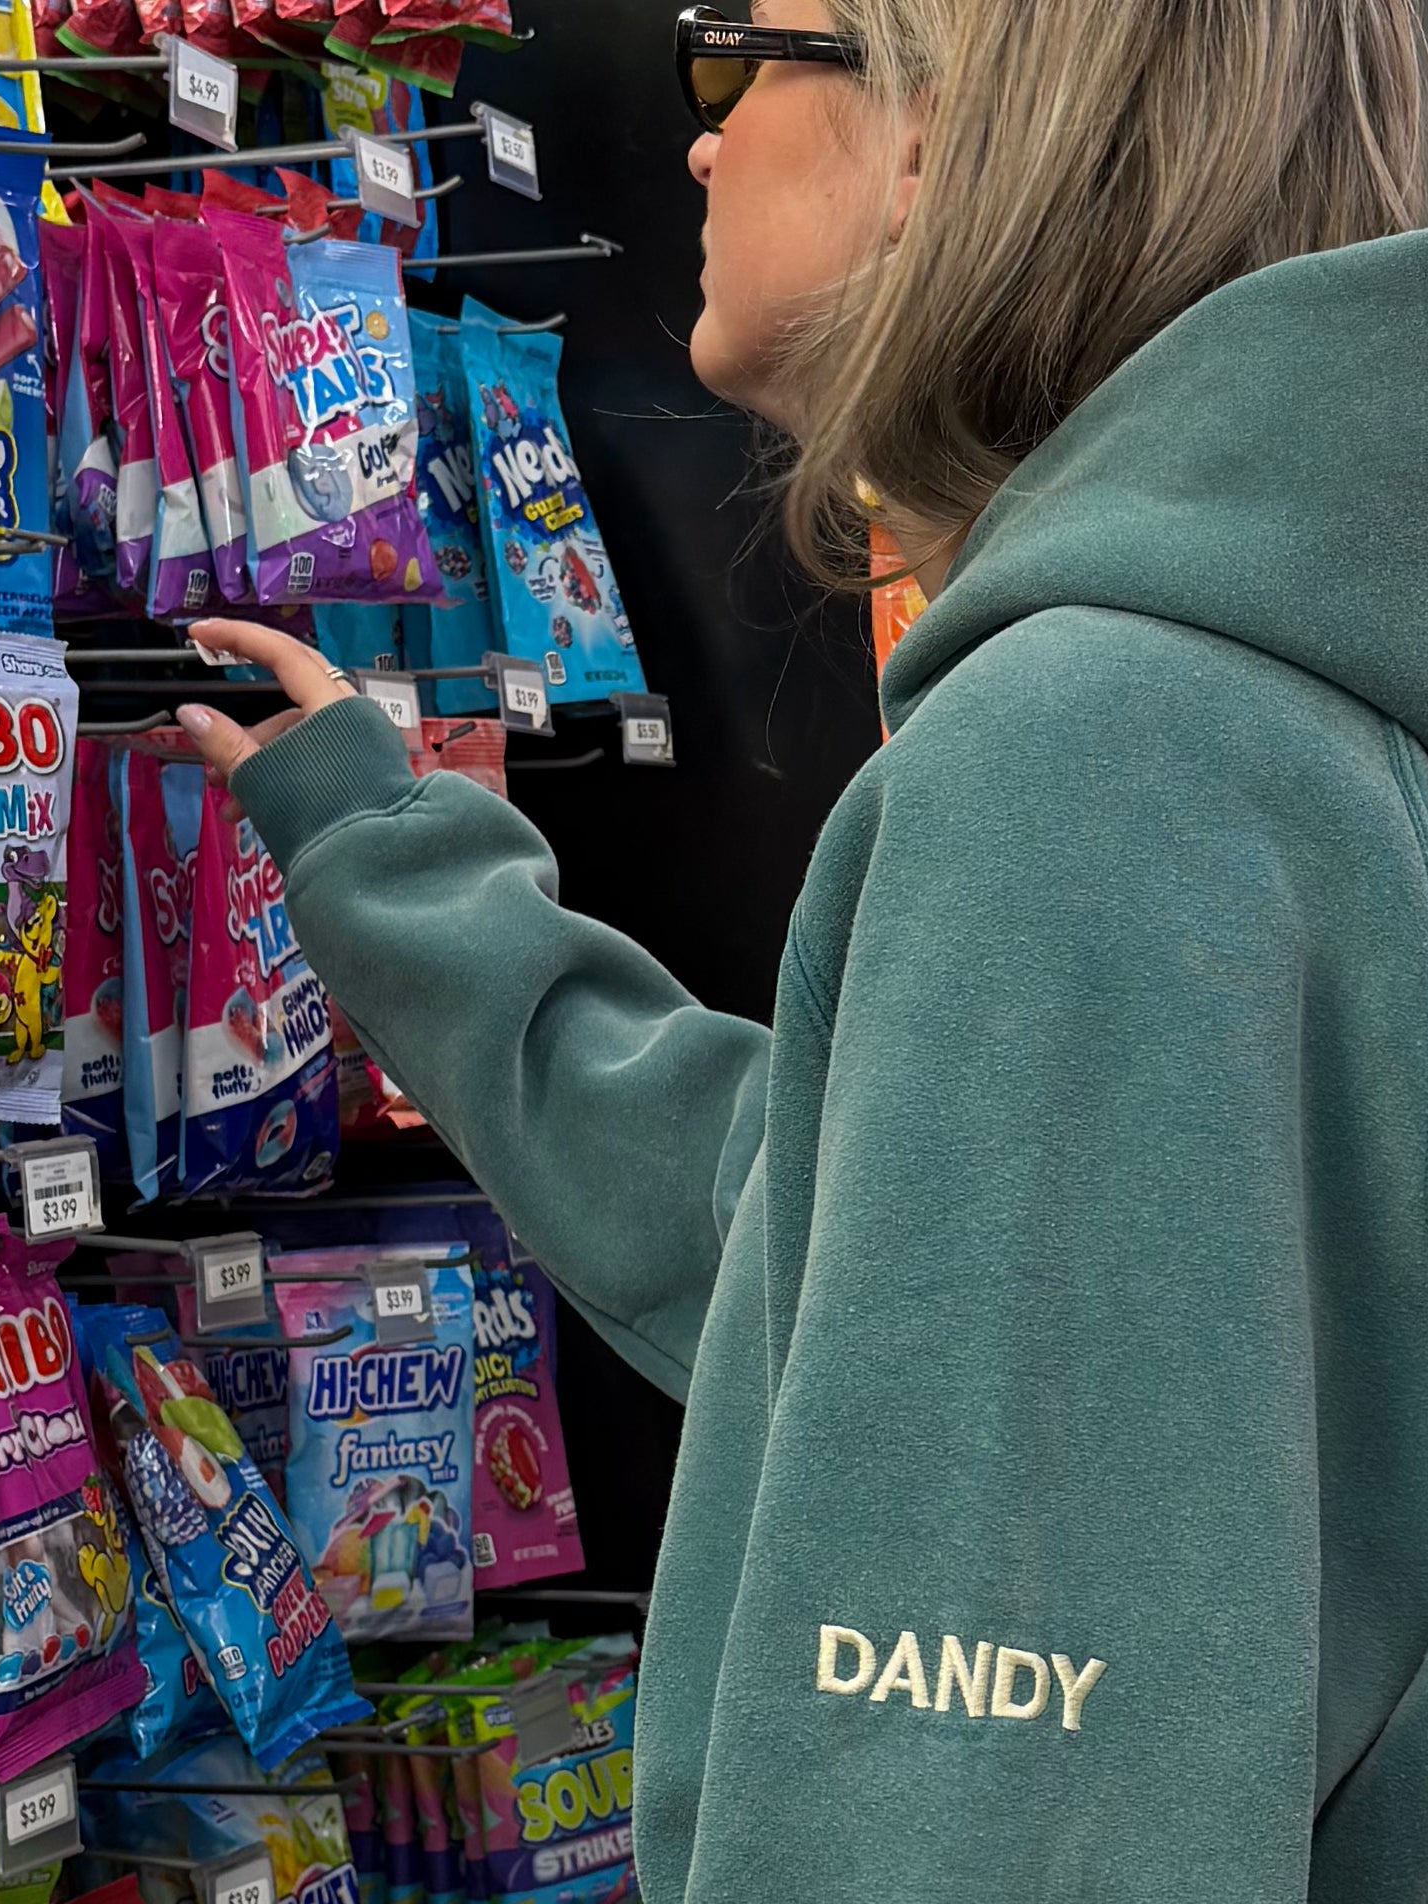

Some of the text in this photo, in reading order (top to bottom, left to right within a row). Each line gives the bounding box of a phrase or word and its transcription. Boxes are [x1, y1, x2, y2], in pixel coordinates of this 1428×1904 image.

[704, 31, 744, 47] QUAY
[188, 73, 220, 102] $4.99
[293, 554, 312, 578] 100
[2, 654, 44, 677] Share
[515, 688, 539, 708] $3.99
[42, 1201, 78, 1225] $3.99
[220, 1263, 252, 1288] $3.99
[385, 1288, 415, 1311] $3.99
[308, 1346, 463, 1418] HI-CHEW
[333, 1430, 456, 1486] fantasy
[816, 1624, 1108, 1731] DANDY
[20, 1794, 56, 1827] $3.99
[534, 1830, 632, 1882] STRIKE
